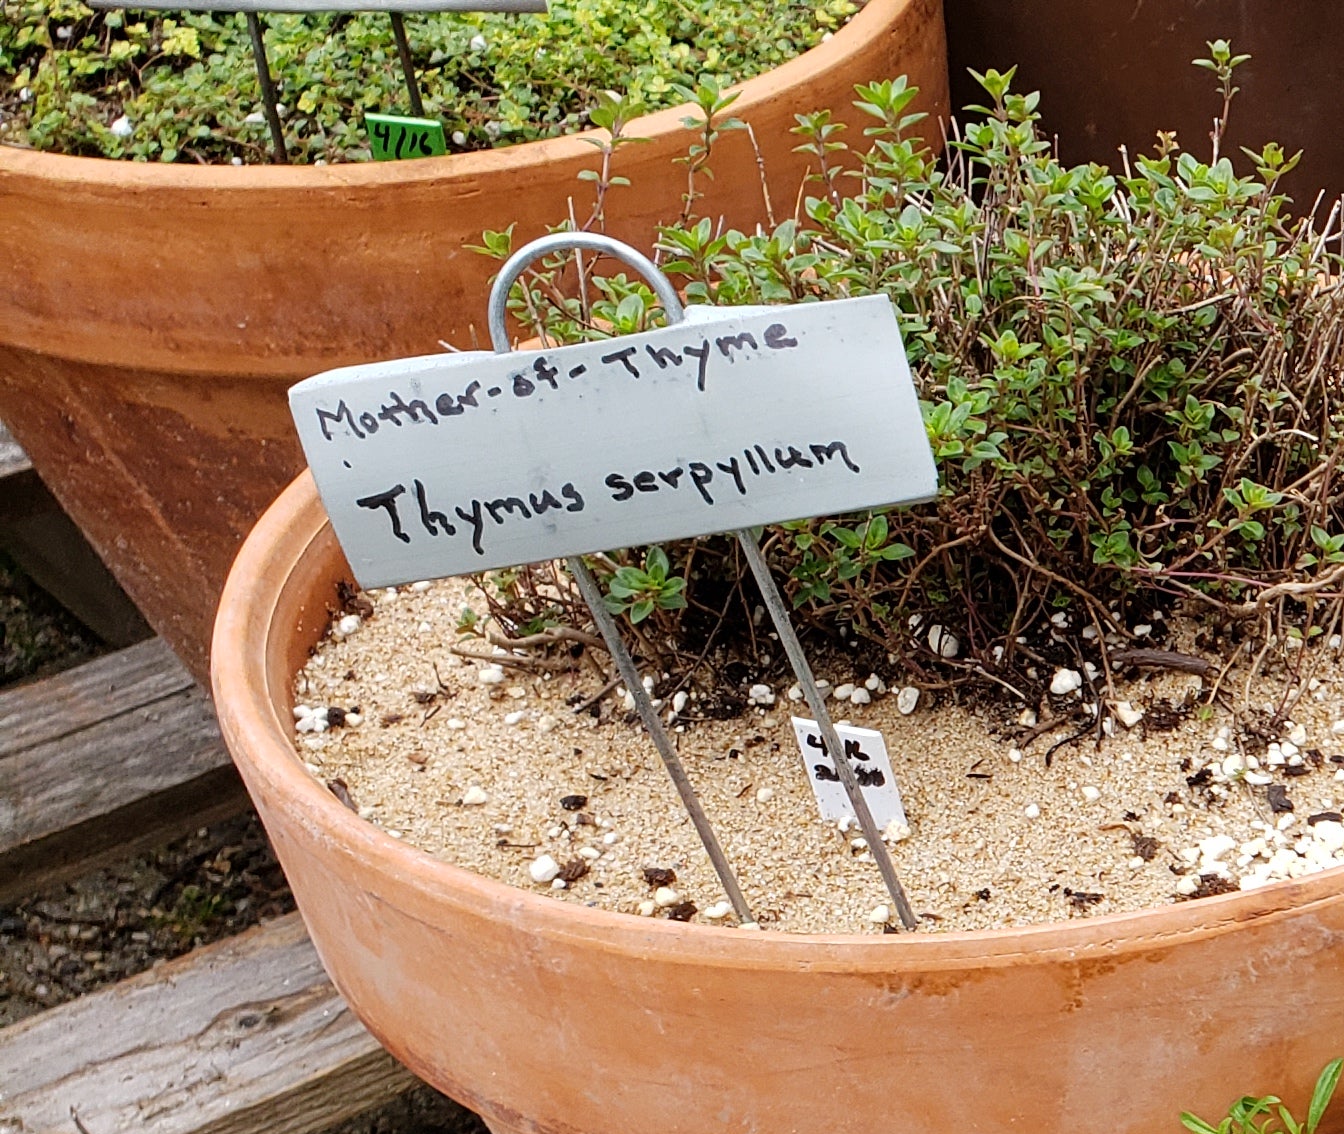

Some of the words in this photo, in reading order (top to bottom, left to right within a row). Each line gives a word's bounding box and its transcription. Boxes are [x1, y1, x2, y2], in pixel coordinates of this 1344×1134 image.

[373, 122, 433, 160] 4/16
[356, 478, 585, 556] Thymus
[604, 441, 860, 506] serpyllum
